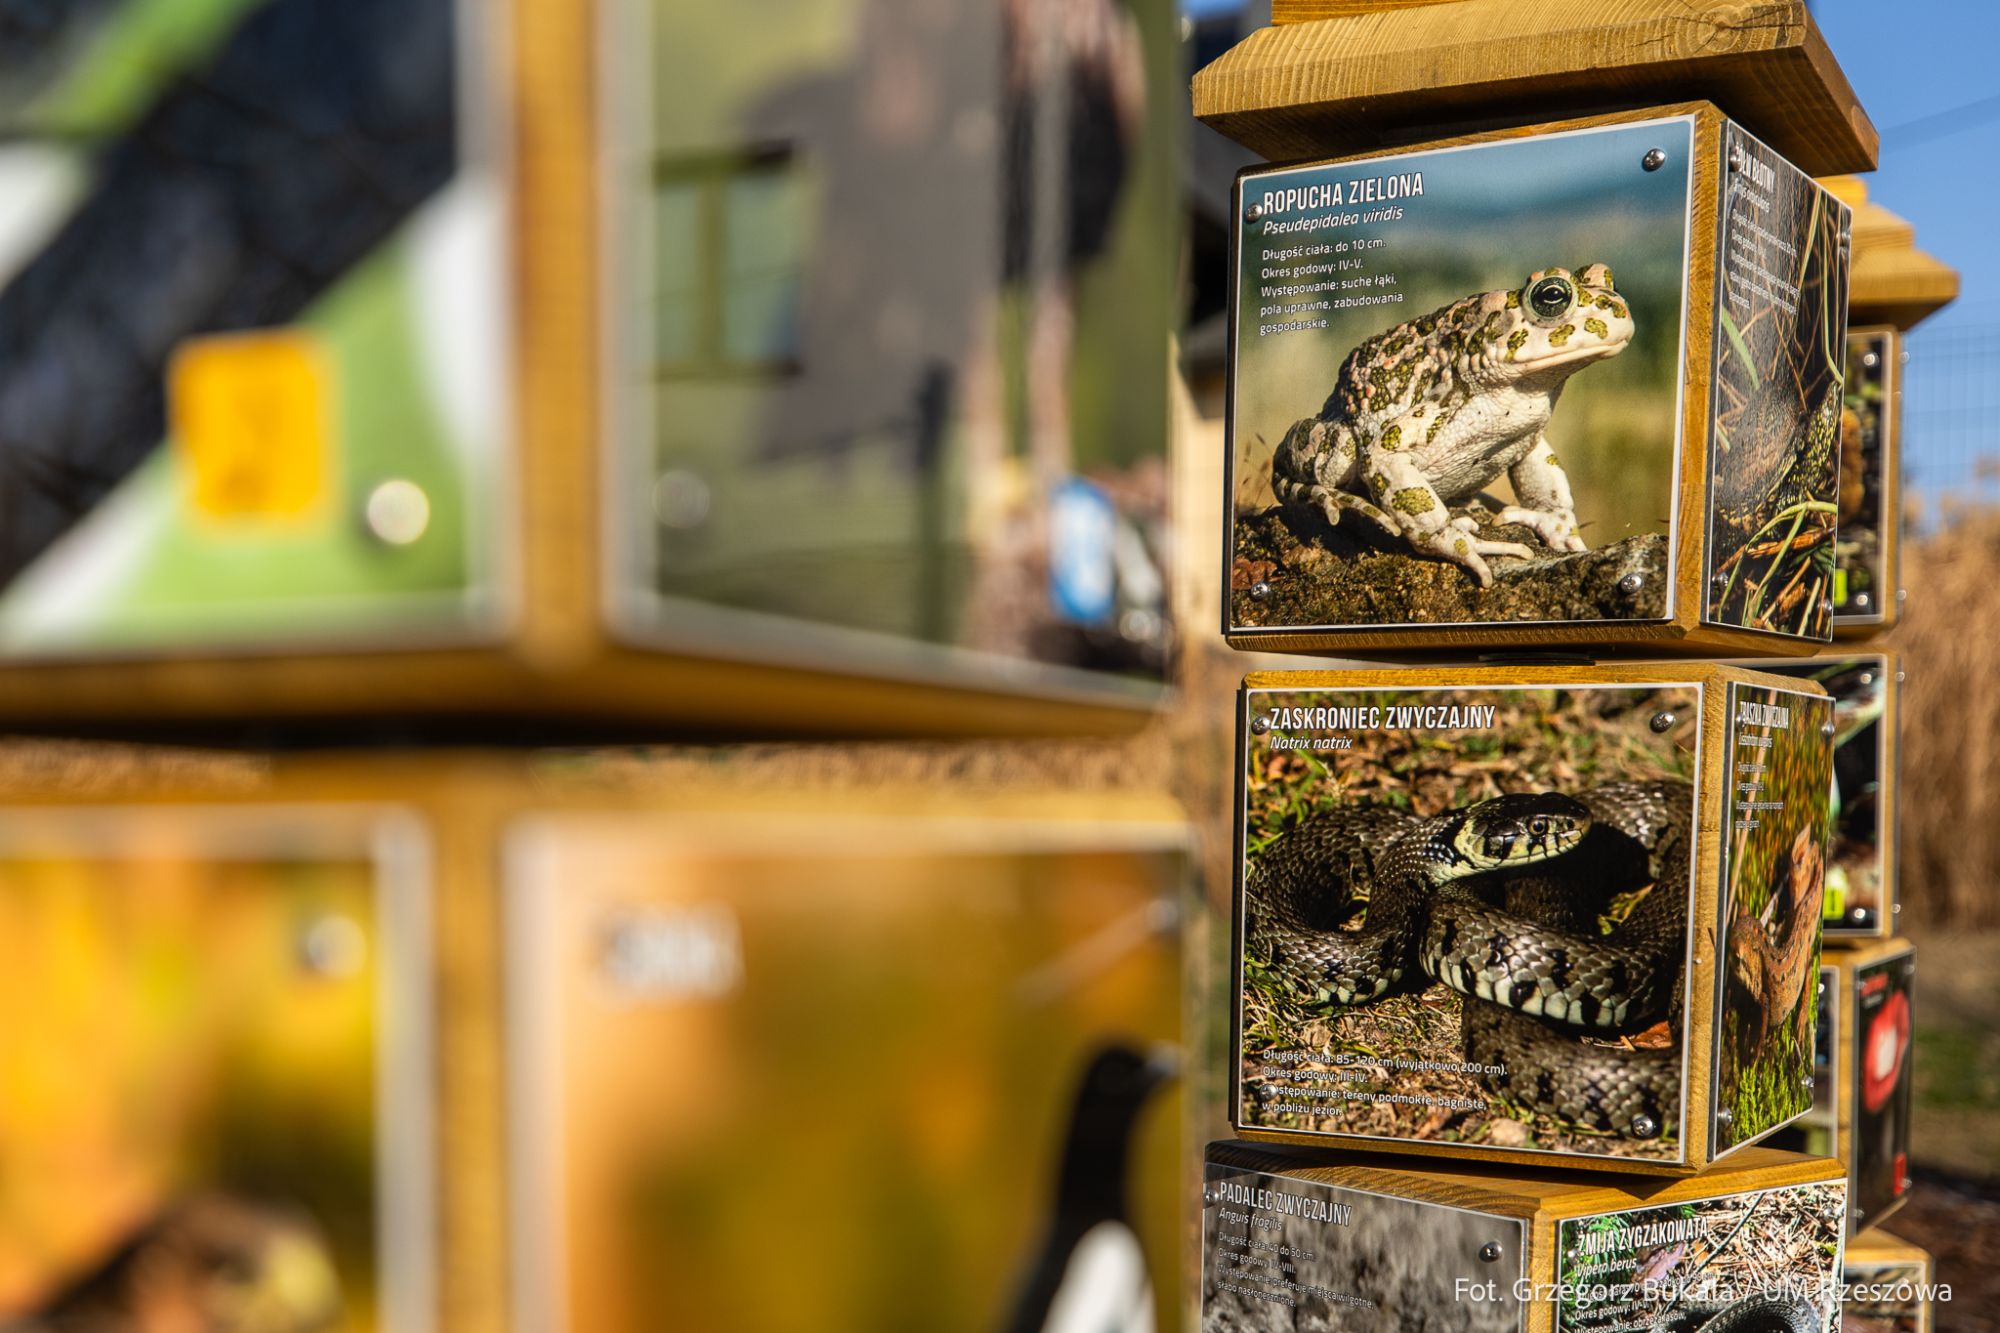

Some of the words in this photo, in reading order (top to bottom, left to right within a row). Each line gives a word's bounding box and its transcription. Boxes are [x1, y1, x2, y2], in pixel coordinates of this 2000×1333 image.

[1263, 183, 1343, 215] ROPUCHA
[1348, 172, 1424, 204] ZIELONA
[1263, 211, 1358, 235] Pseudepidalea
[1363, 206, 1404, 223] viridis
[1262, 246, 1303, 262] Długość
[1305, 244, 1333, 257] ciała:
[1335, 241, 1349, 253] do
[1352, 239, 1365, 250] 10
[1367, 238, 1387, 249] cm.
[1261, 266, 1291, 279] Okres
[1293, 262, 1336, 278] godowy:
[1339, 258, 1364, 271] IV-V.
[1261, 279, 1339, 298] Występowanie:
[1341, 276, 1372, 289] suche
[1260, 303, 1281, 317] pola
[1284, 300, 1331, 315] uprawne,
[1334, 292, 1404, 309] zabudowania
[1260, 318, 1330, 337] gospodarskie.
[1270, 707, 1380, 730] ZASKRONIEC
[1385, 705, 1496, 729] ZWYCZAJNY
[1270, 736, 1310, 750] Natrix
[1313, 736, 1352, 750] natrix
[1263, 1049, 1303, 1063] Długość
[1306, 1052, 1333, 1063] ciała:
[1378, 1058, 1393, 1067] cm
[1396, 1058, 1458, 1072] (wyjątkowo
[1461, 1062, 1481, 1073] 200
[1484, 1063, 1508, 1076] cm).
[1263, 1066, 1292, 1078] Okres
[1294, 1069, 1337, 1082] godowy:
[1340, 1071, 1368, 1083] III-IV.
[1262, 1103, 1272, 1111] w
[1273, 1102, 1309, 1114] pobliżu
[1273, 1085, 1340, 1099] stępowanie:
[1343, 1090, 1376, 1104] tereny
[1438, 1096, 1488, 1111] bagniste,
[1220, 1182, 1273, 1211] PADALEC
[1276, 1192, 1352, 1227] ZWYCZAJNY
[1219, 1207, 1249, 1225] Anguis
[1250, 1213, 1282, 1232] fragilis
[1218, 1231, 1247, 1247] Długość
[1280, 1246, 1290, 1256] do
[1291, 1248, 1301, 1258] 50
[1579, 1229, 1615, 1256] ŻMIJA
[1619, 1217, 1708, 1250] ZYGZAKOWATA
[1218, 1247, 1239, 1261] Okres
[1577, 1262, 1608, 1279] Vipera
[1610, 1258, 1637, 1272] berus
[1575, 1309, 1597, 1320] Okres
[1598, 1304, 1631, 1319] godowy:
